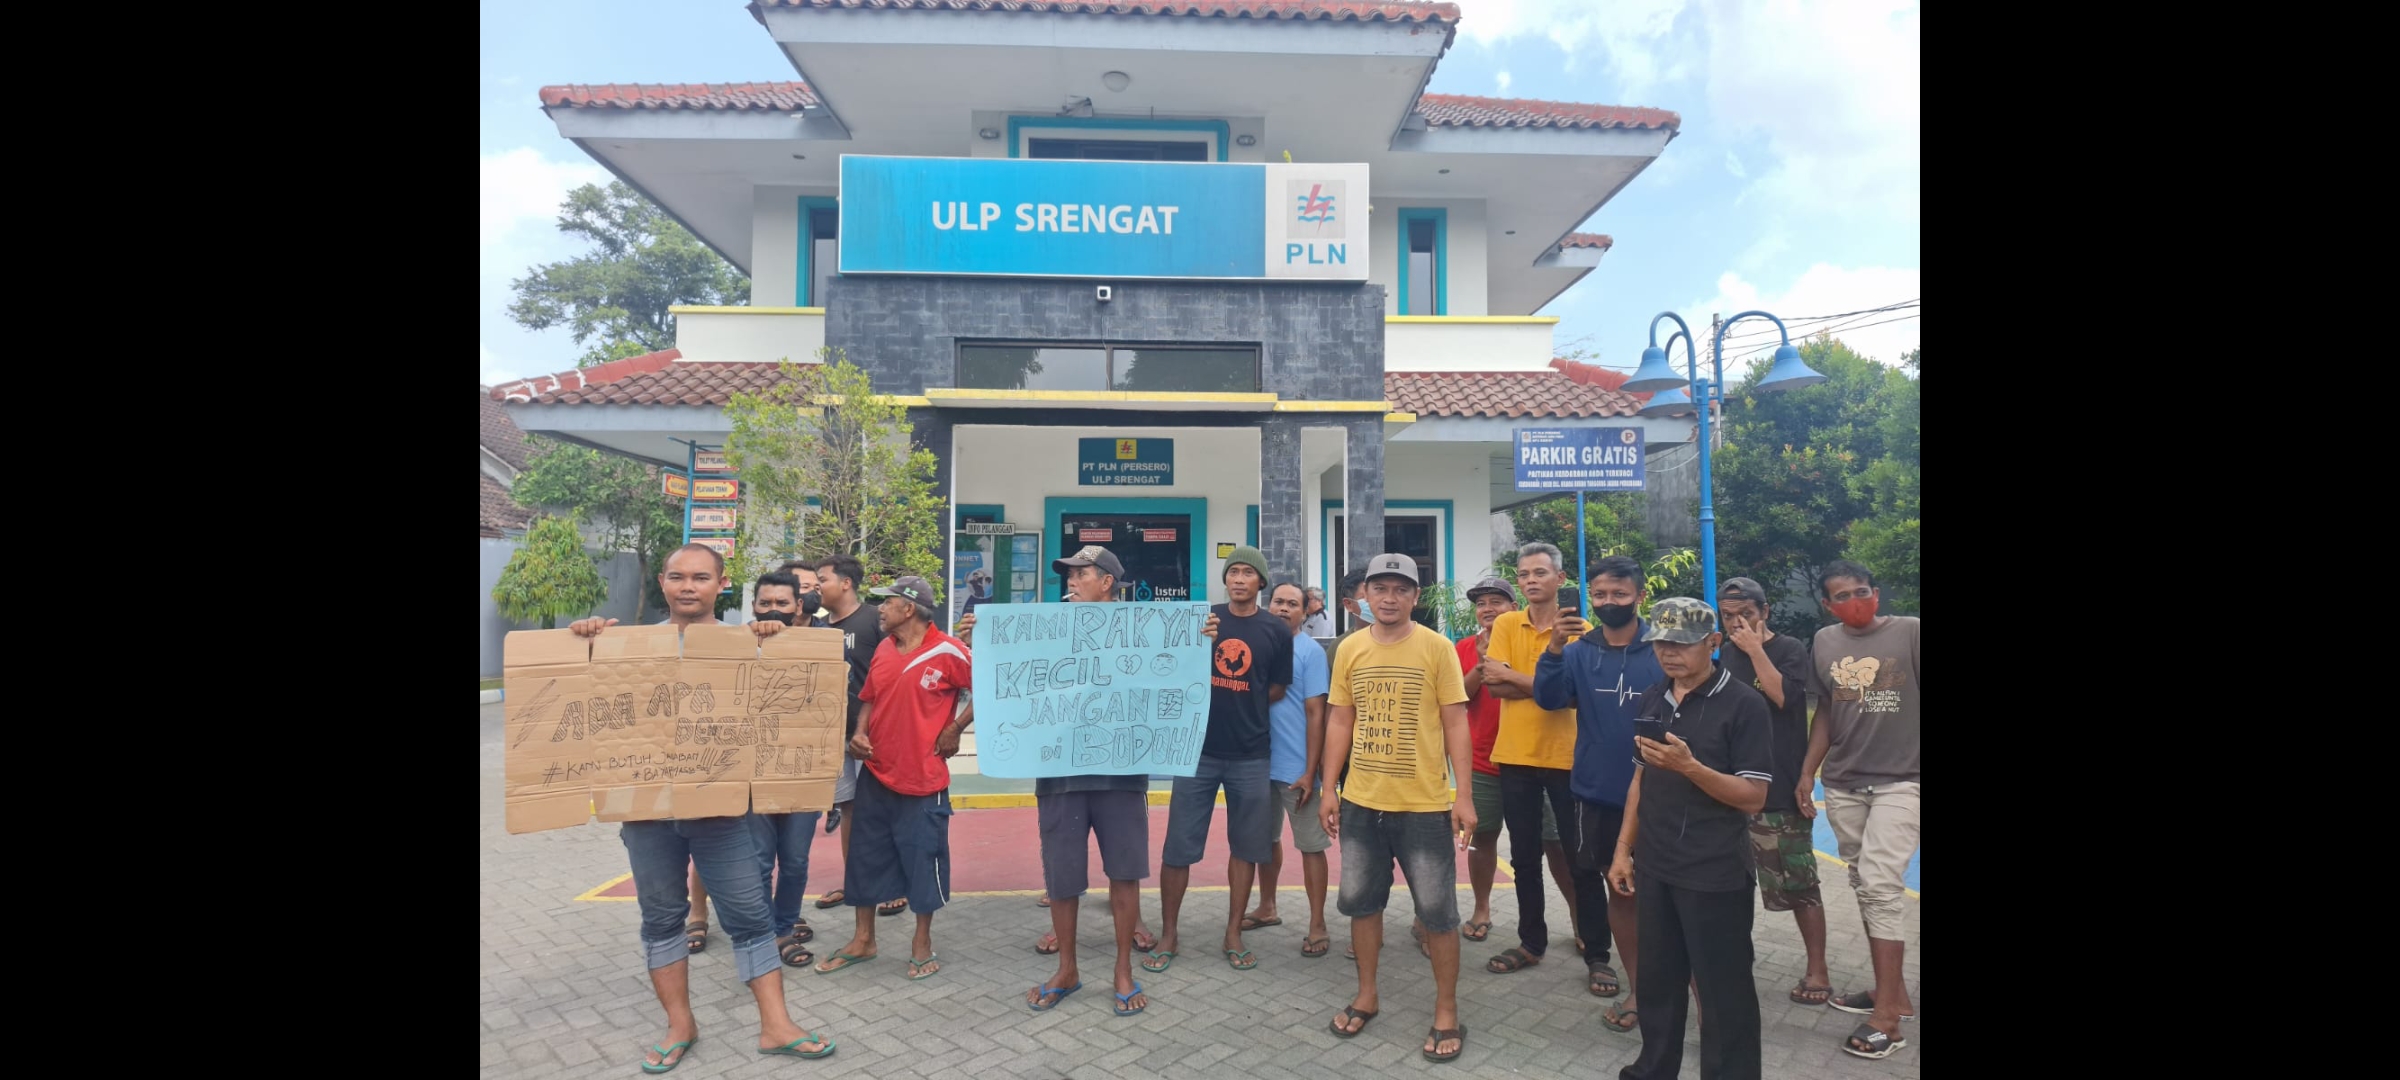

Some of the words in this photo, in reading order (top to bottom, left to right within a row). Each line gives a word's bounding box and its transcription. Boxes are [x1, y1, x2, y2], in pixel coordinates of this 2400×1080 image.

[932, 201, 1001, 230] ULP
[1015, 203, 1179, 234] SRENGAT
[1286, 243, 1346, 264] PLN
[1521, 446, 1576, 465] PARKIR
[1582, 446, 1637, 465] GRATIS
[1082, 462, 1095, 471] PT
[1099, 462, 1117, 471] PLN
[1121, 462, 1170, 473] (PERSERO)
[1092, 475, 1111, 484] ULP
[1114, 475, 1161, 484] SRENGAT
[968, 525, 981, 533] INFO
[981, 525, 1013, 533] PELANGGAN
[1155, 586, 1187, 596] listrik
[1072, 605, 1209, 653] RAKYAT
[995, 656, 1112, 700] KECIL
[551, 693, 636, 742] ADA
[647, 682, 715, 717] APA
[1010, 689, 1150, 729] JANGAN
[1368, 697, 1396, 711] STOP
[1363, 741, 1393, 755] PROUD
[609, 753, 650, 769] BUTUH
[755, 744, 813, 777] PLN
